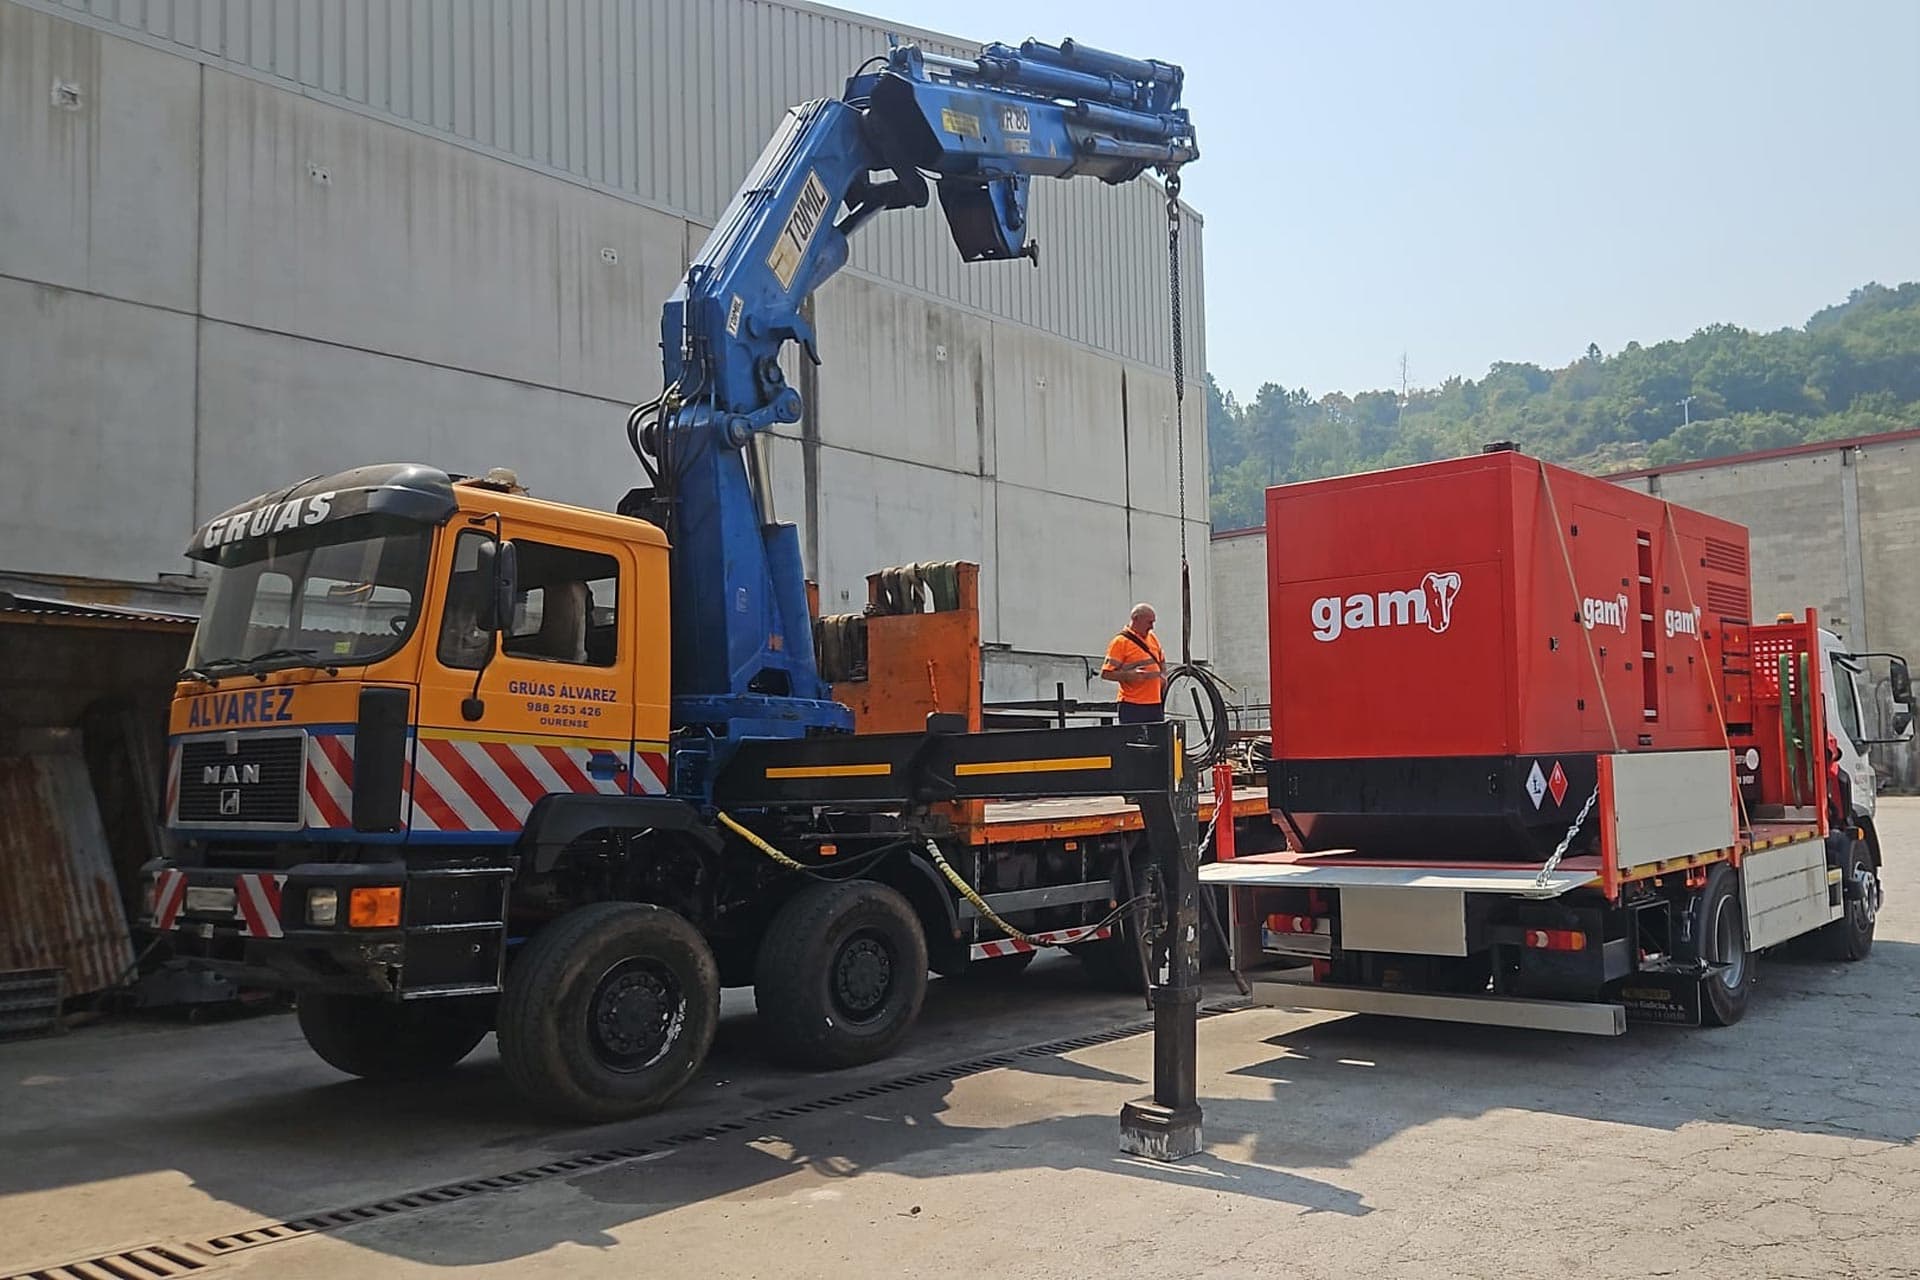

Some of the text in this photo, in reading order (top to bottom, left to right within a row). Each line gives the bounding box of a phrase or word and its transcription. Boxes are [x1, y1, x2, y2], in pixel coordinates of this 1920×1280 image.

[784, 177, 826, 253] TOIMIL
[203, 491, 336, 549] GRUAS
[1311, 588, 1427, 642] gam
[1583, 597, 1620, 630] gam
[1664, 608, 1696, 638] gam
[188, 687, 295, 728] ALVAREZ
[527, 702, 550, 713] 988
[553, 704, 576, 715] 253
[539, 717, 590, 728] OURENSE
[203, 764, 260, 784] MAN
